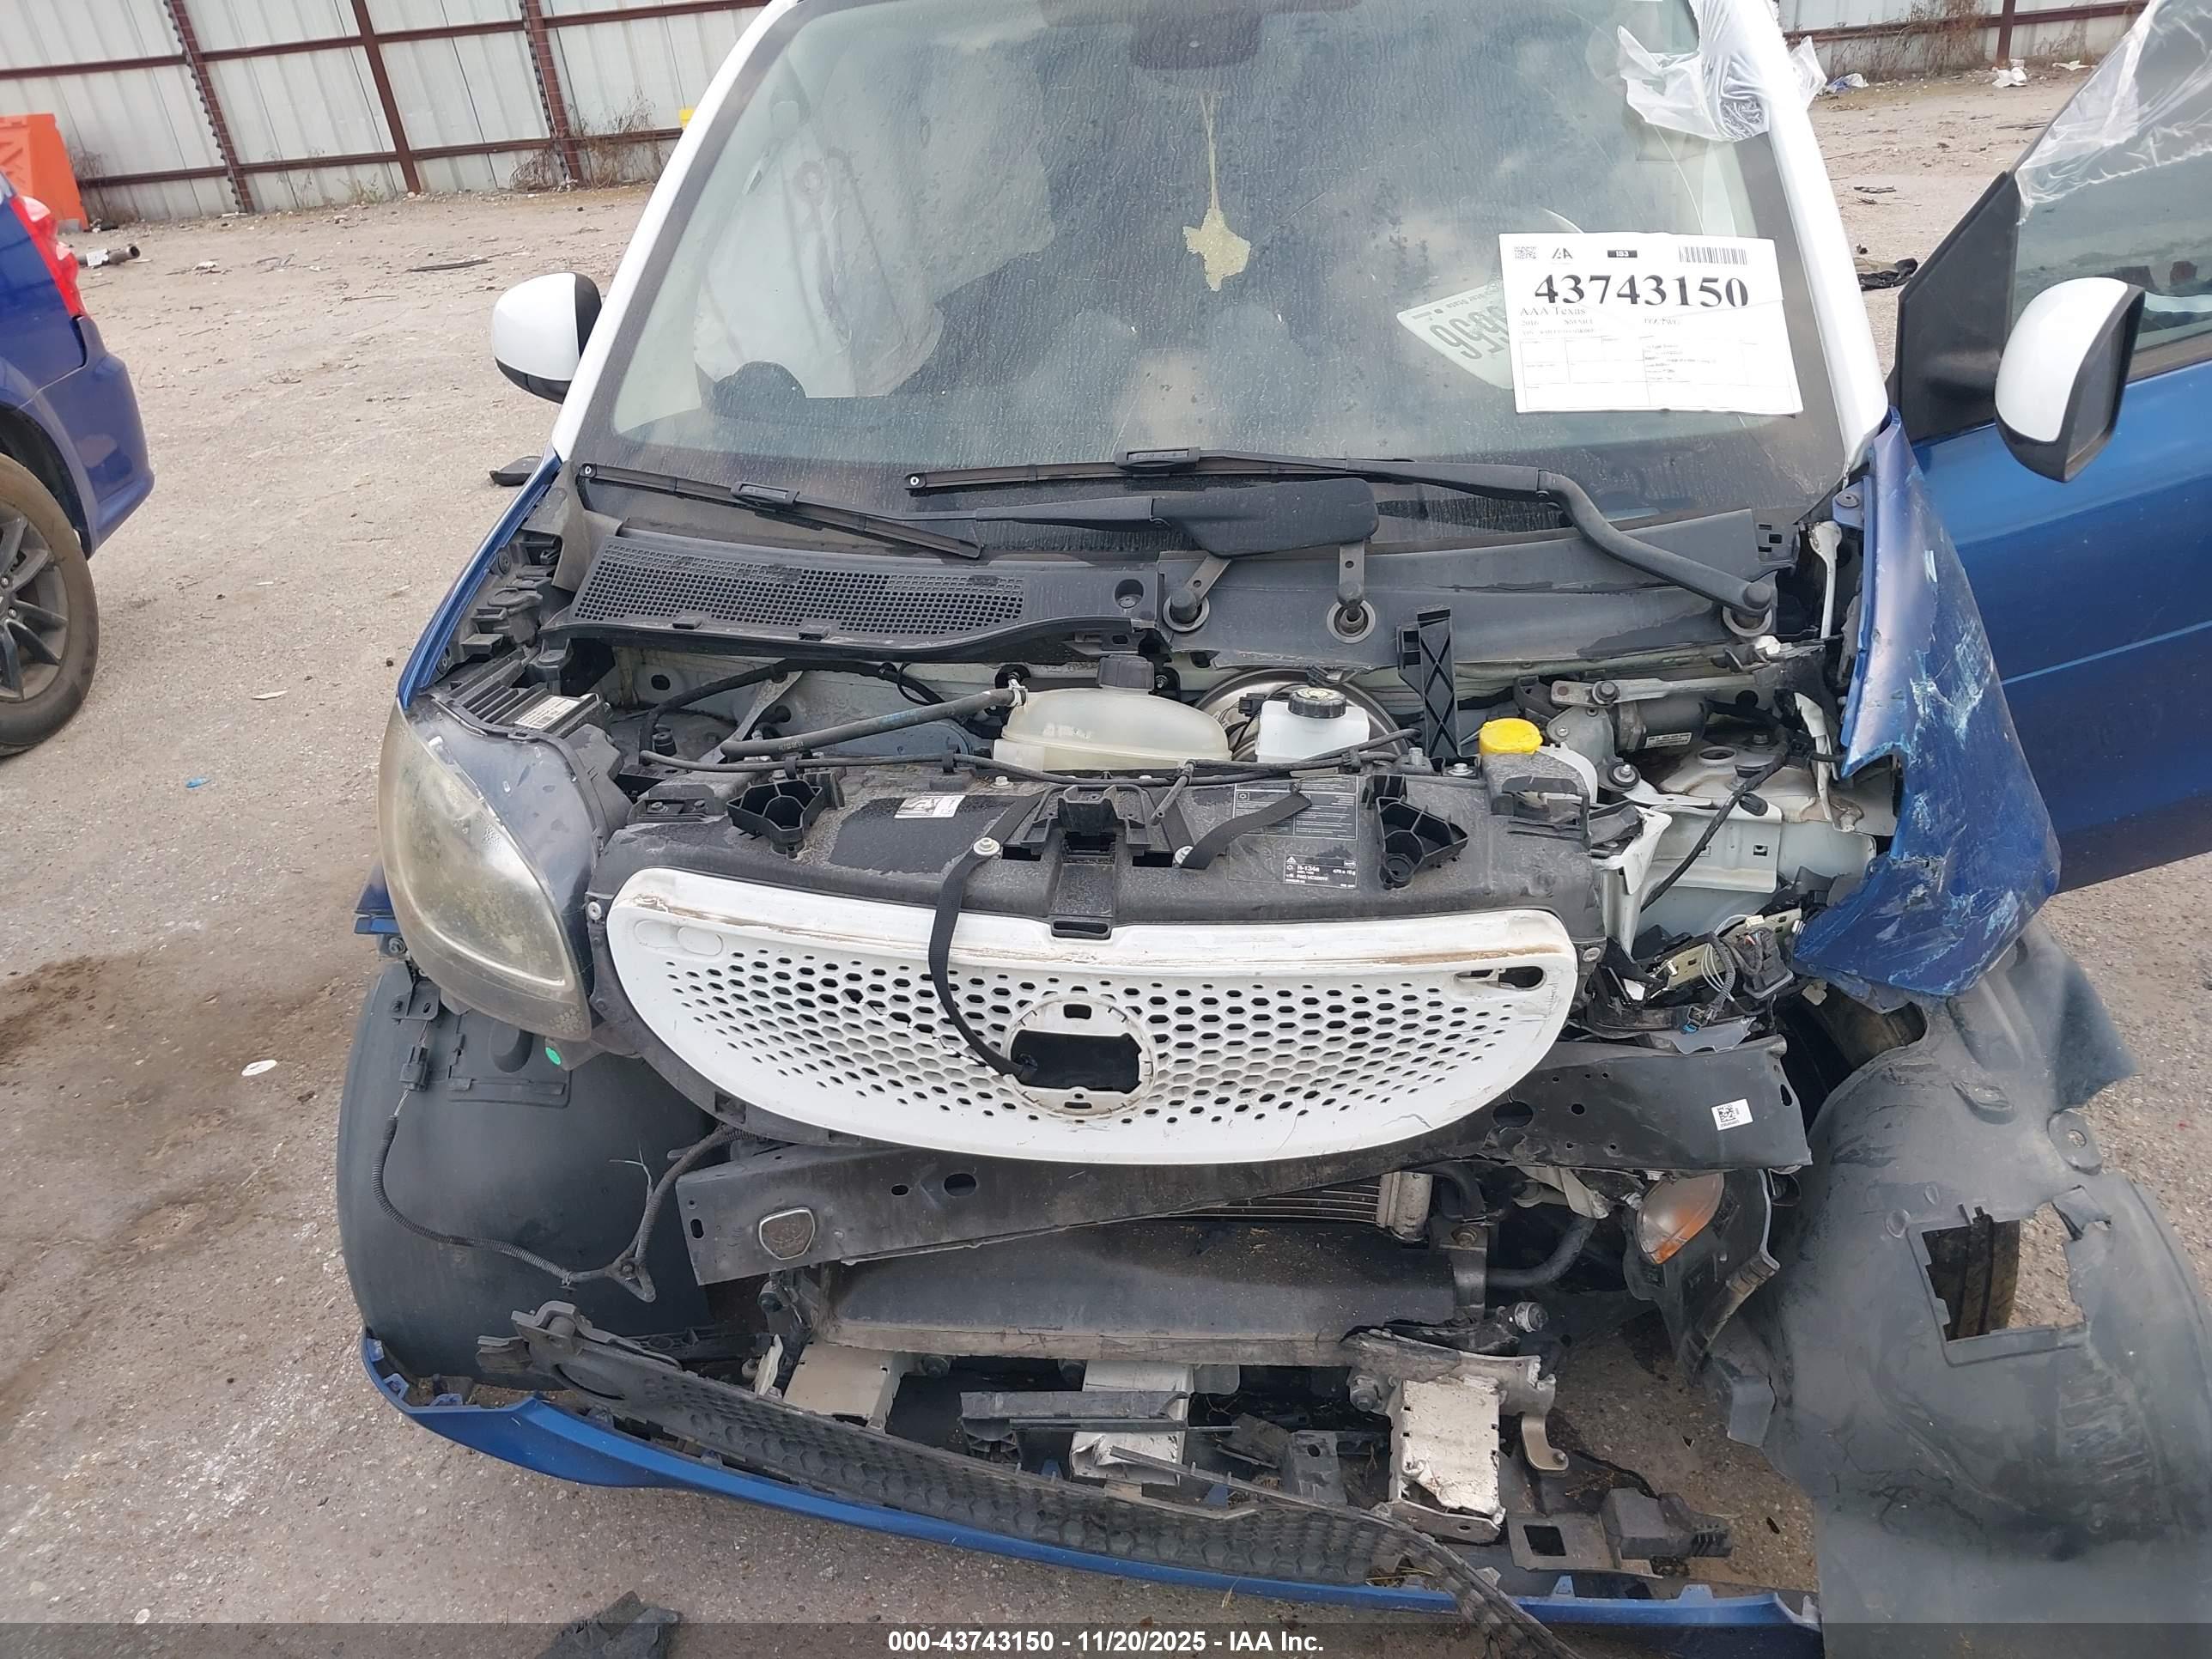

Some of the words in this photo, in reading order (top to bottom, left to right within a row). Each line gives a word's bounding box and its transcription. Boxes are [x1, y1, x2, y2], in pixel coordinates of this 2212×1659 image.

[1534, 274, 1748, 307] 43743150
[1521, 307, 1549, 316] AAA
[1553, 306, 1586, 316] Texas
